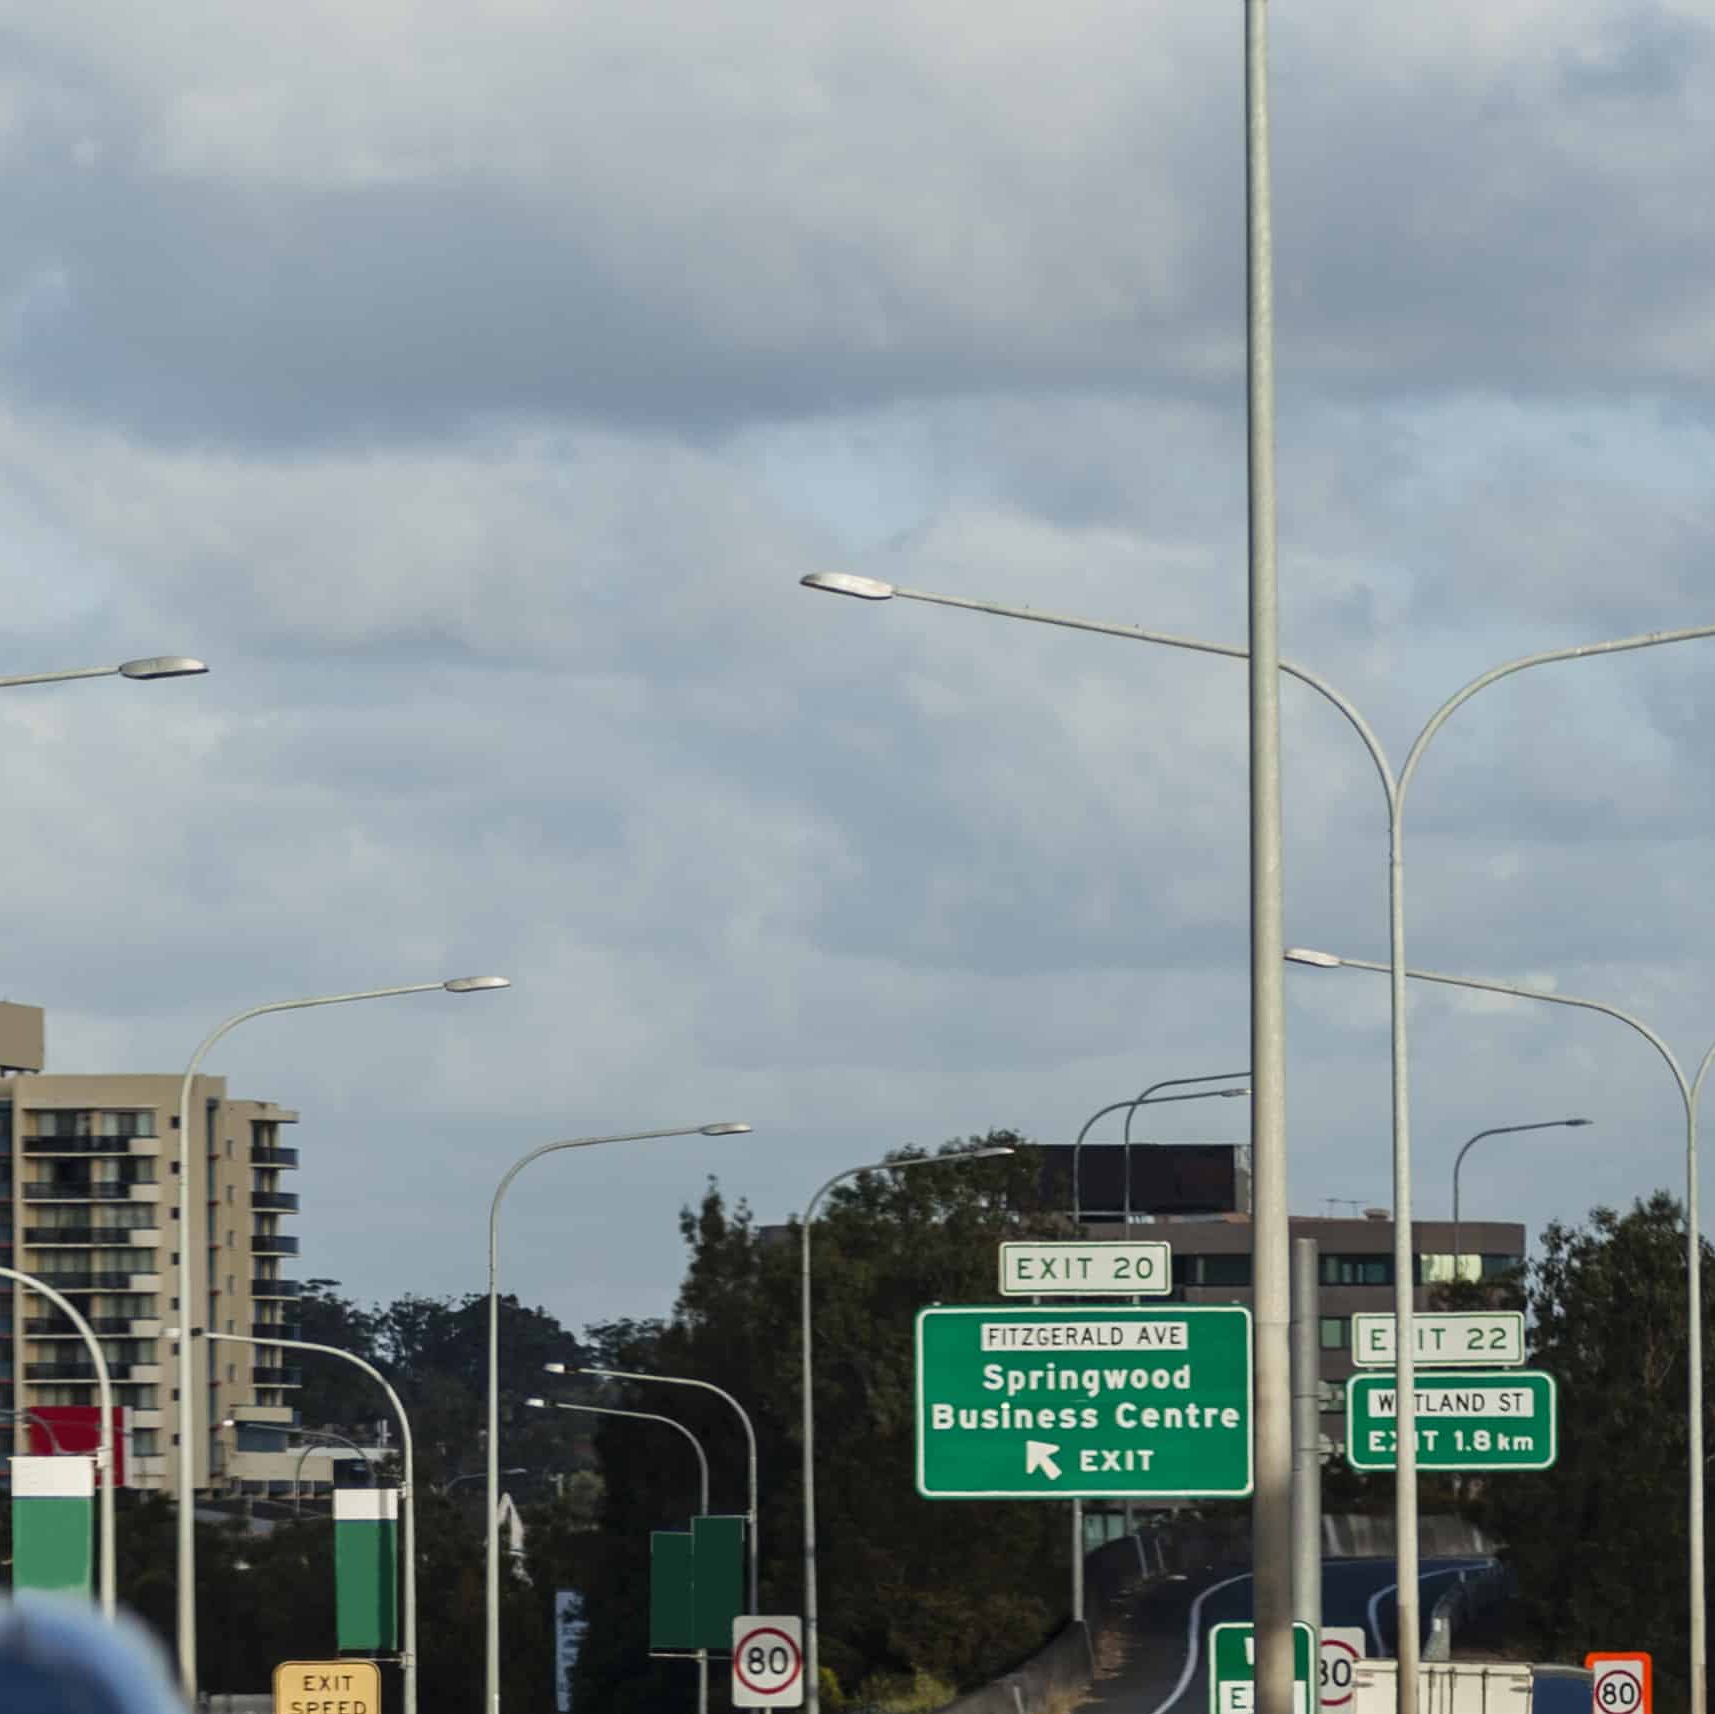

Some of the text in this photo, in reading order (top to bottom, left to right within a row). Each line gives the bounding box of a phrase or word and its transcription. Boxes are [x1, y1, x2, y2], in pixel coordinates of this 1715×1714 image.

[1017, 1257, 1154, 1280] EXIT 20
[988, 1325, 1183, 1347] FITZGERALD AVE
[1371, 1328, 1507, 1351] EIT 22
[982, 1362, 1192, 1398] Springwood
[1378, 1392, 1524, 1413] WTLAND ST
[931, 1402, 1241, 1430] Business Centre
[1454, 1429, 1492, 1452] 1.8
[1497, 1433, 1534, 1452] km
[1079, 1450, 1155, 1472] EXIT
[747, 1646, 789, 1675] 80
[303, 1675, 354, 1691] EXIT
[1601, 1682, 1635, 1705] 80
